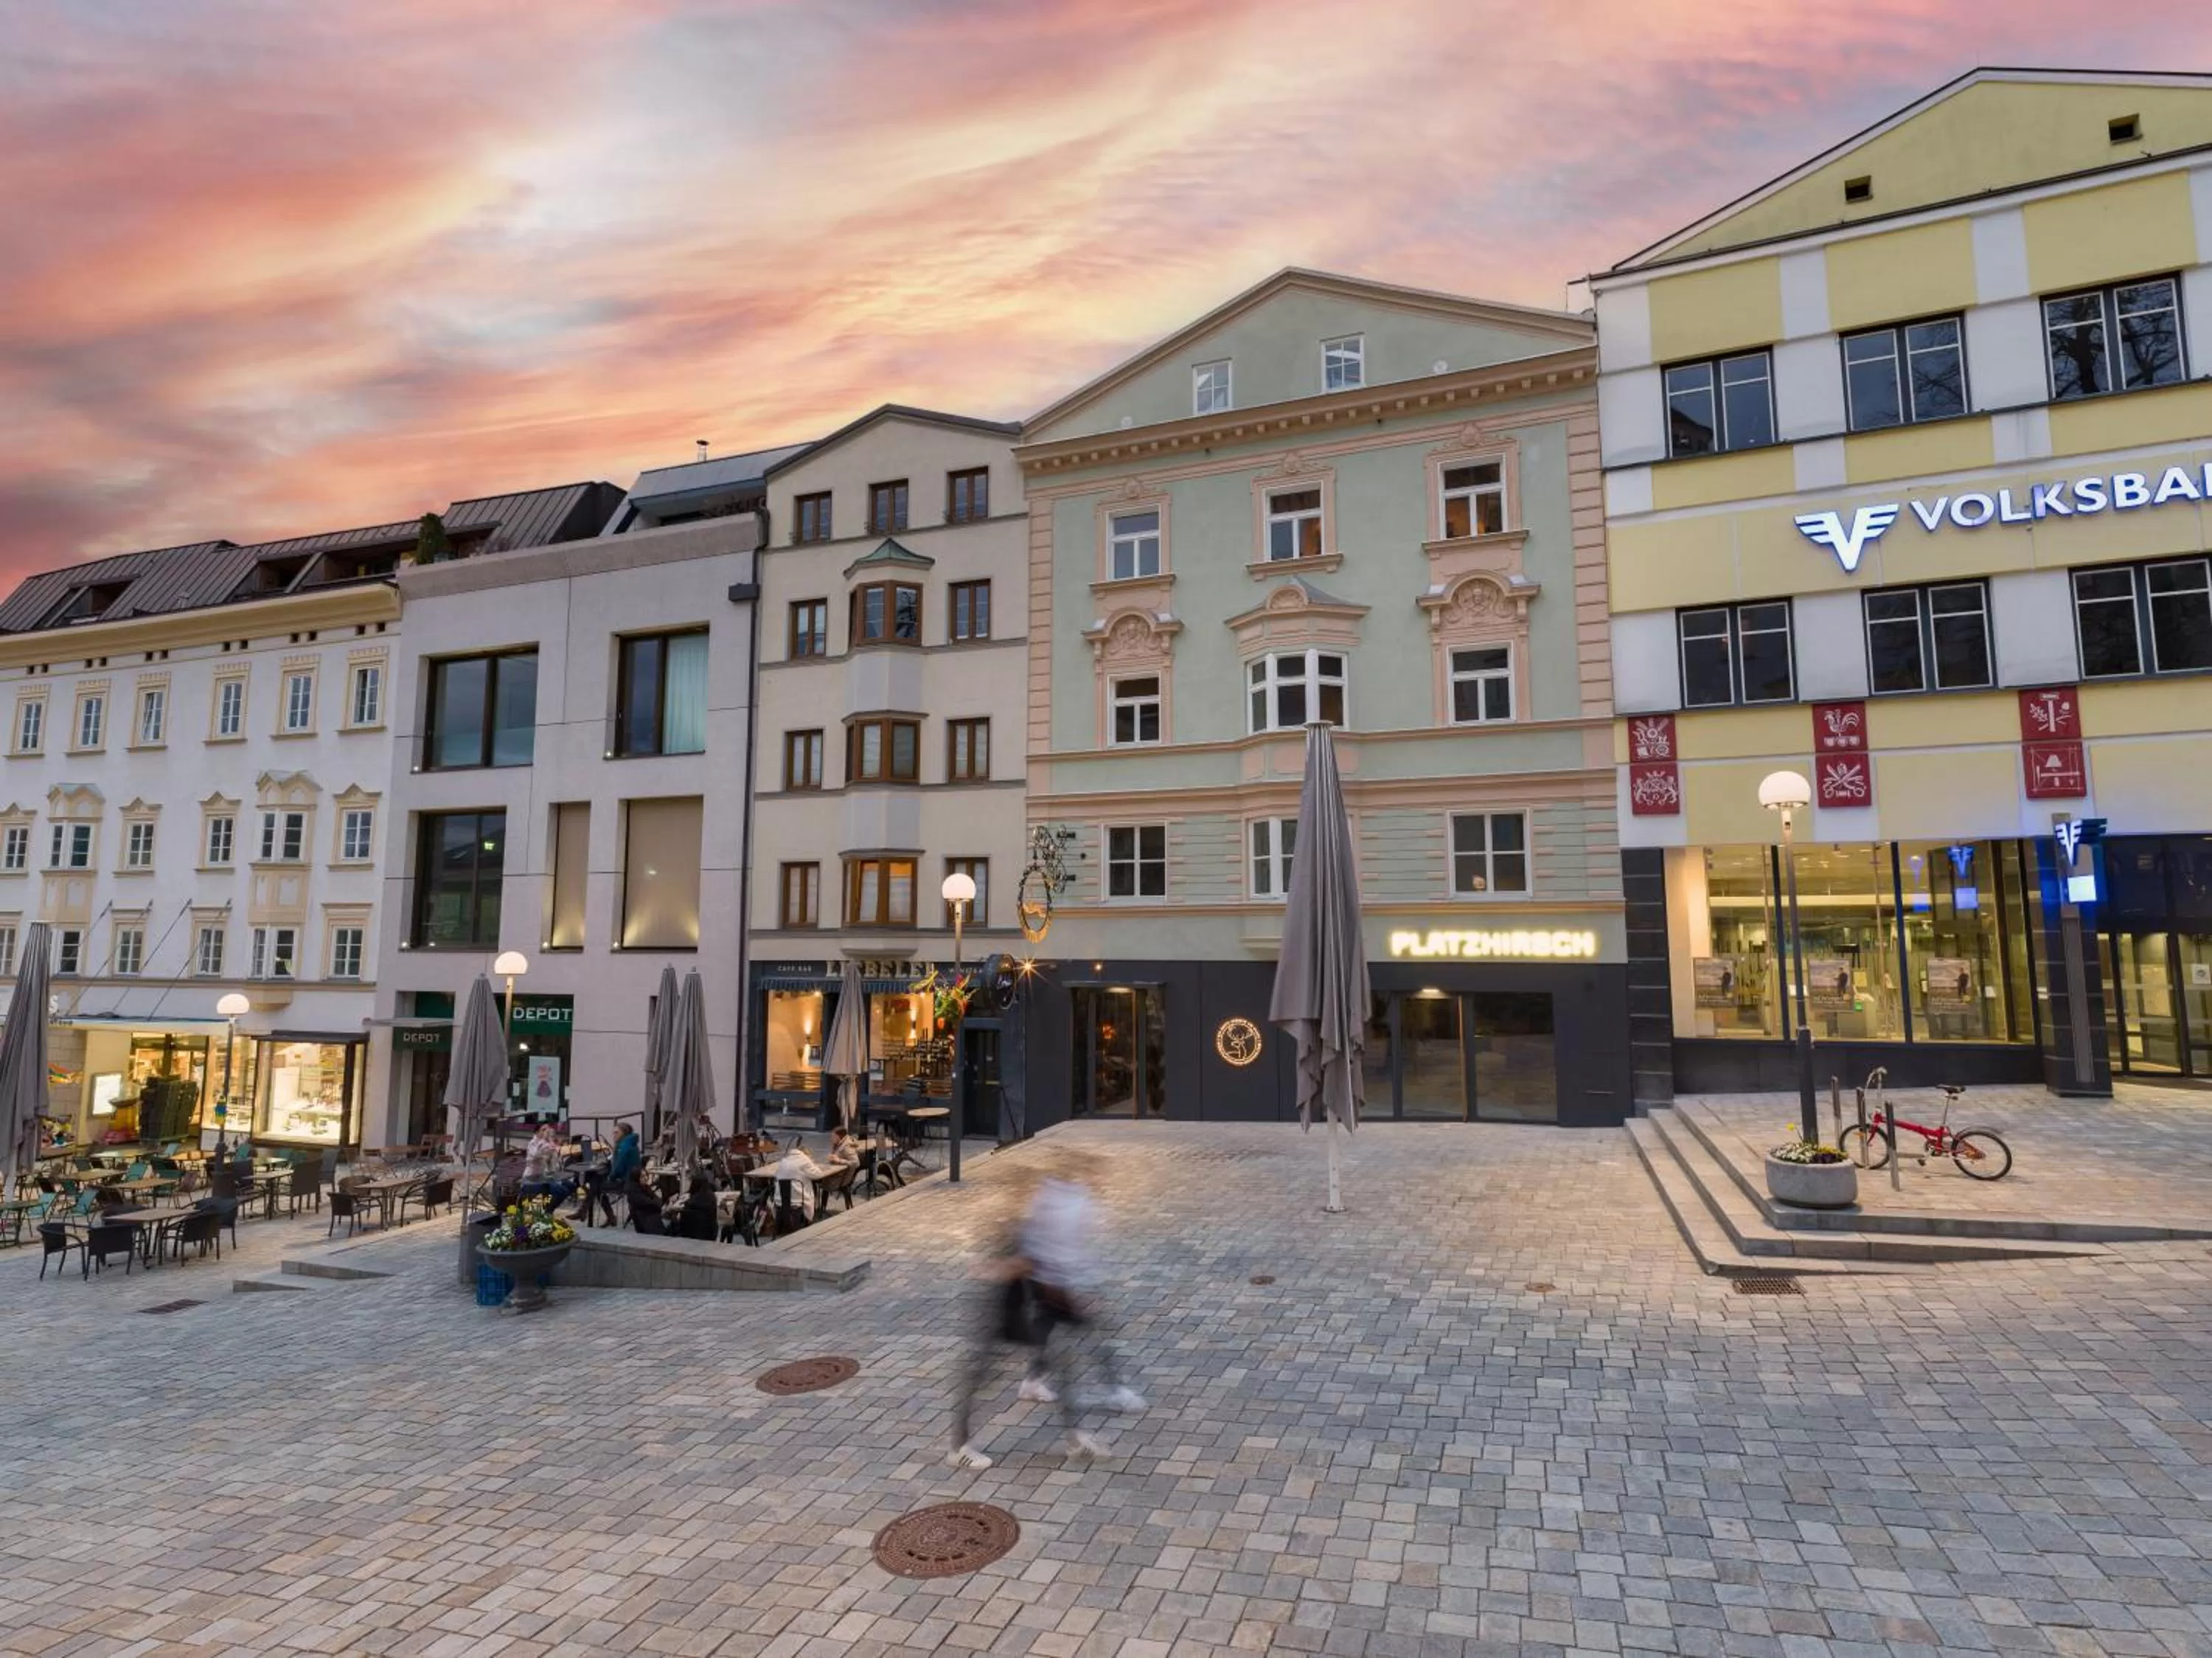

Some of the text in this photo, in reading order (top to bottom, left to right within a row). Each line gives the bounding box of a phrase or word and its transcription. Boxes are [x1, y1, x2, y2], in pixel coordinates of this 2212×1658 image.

[1910, 462, 2212, 532] VOLKSBA
[1391, 932, 1595, 956] PLATZHIRSCH
[512, 1007, 573, 1021] DEPOT
[403, 1033, 440, 1043] DEPOT
